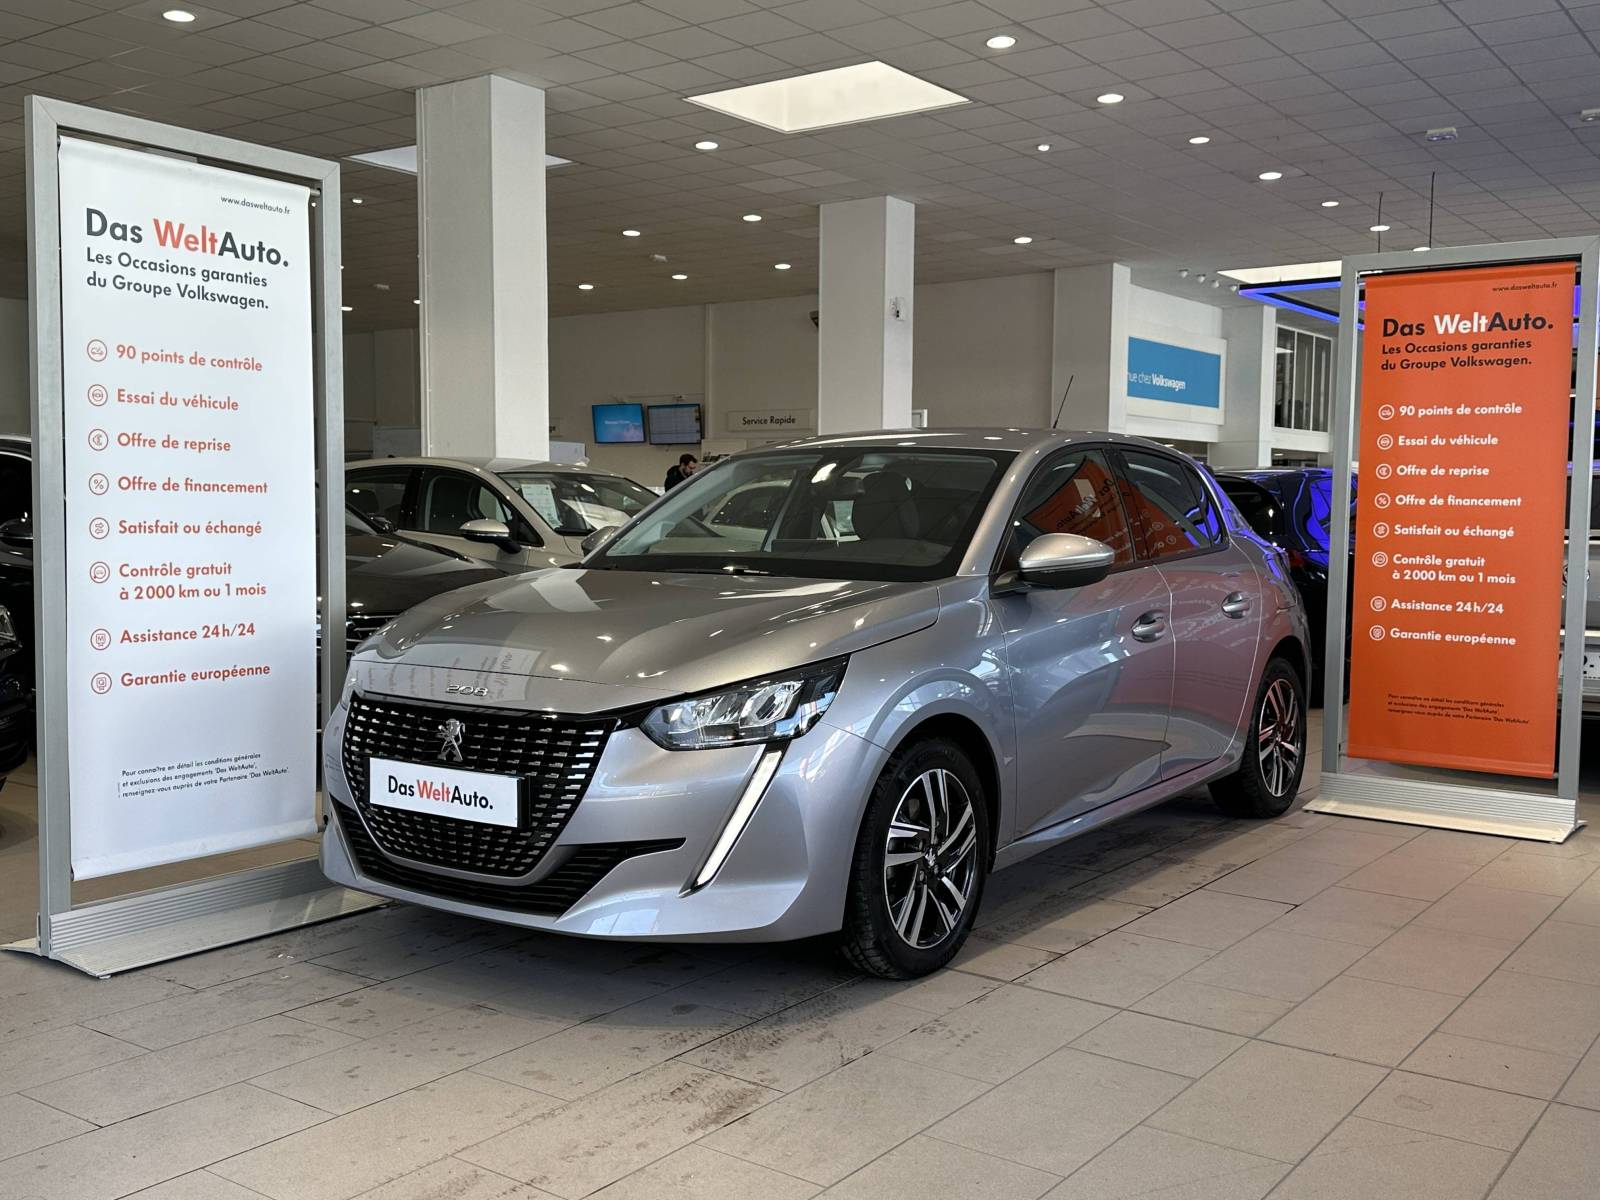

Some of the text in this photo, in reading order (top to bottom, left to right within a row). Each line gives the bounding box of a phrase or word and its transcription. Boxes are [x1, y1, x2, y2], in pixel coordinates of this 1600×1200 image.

[220, 195, 291, 215] www.dasweltauto.fr
[86, 207, 289, 267] Das WeltAuto.
[87, 247, 268, 287] Les Occasions garanties
[87, 271, 269, 310] du Groupe Volkswagen.
[1383, 312, 1553, 337] Das WeltAuto.
[1382, 339, 1532, 354] Les Occasions garanties
[116, 344, 262, 372] 90 points de contrôle
[1381, 355, 1532, 371] du Groupe Volkswagen.
[1152, 373, 1186, 391] Volkswagen
[117, 389, 239, 411] Essai du véhicule
[1400, 402, 1522, 417] 90 points de contrôle
[742, 415, 796, 426] Service Rapide
[117, 432, 231, 453] Offre de reprise
[1398, 434, 1498, 446] Essai du véhicule
[1397, 465, 1489, 477] Offre de reprise
[118, 476, 268, 494] Offre de financement
[1395, 495, 1522, 507] Offre de financement
[118, 520, 262, 537] Satisfait ou échangé
[1394, 525, 1514, 539] Satisfait ou échangé
[1393, 554, 1485, 568] Contrôle gratuit
[119, 562, 232, 579] Contrôle gratuit
[1392, 570, 1400, 580] à
[1439, 571, 1456, 581] km
[1459, 574, 1474, 582] ou
[1478, 573, 1484, 582] 1
[1487, 573, 1516, 584] mois
[120, 586, 129, 600] à
[179, 584, 200, 598] km
[204, 586, 220, 597] ou
[225, 583, 231, 596] 1
[236, 583, 267, 596] mois
[1391, 599, 1453, 611] Assistance
[120, 627, 198, 644] Assistance
[1390, 628, 1516, 645] Garantie européenne
[121, 665, 271, 687] Garantie européenne
[446, 684, 489, 697] 208
[204, 756, 233, 766] conditions
[162, 774, 173, 782] des
[174, 768, 213, 781] engagements
[388, 775, 493, 810] Das WeltAuto.
